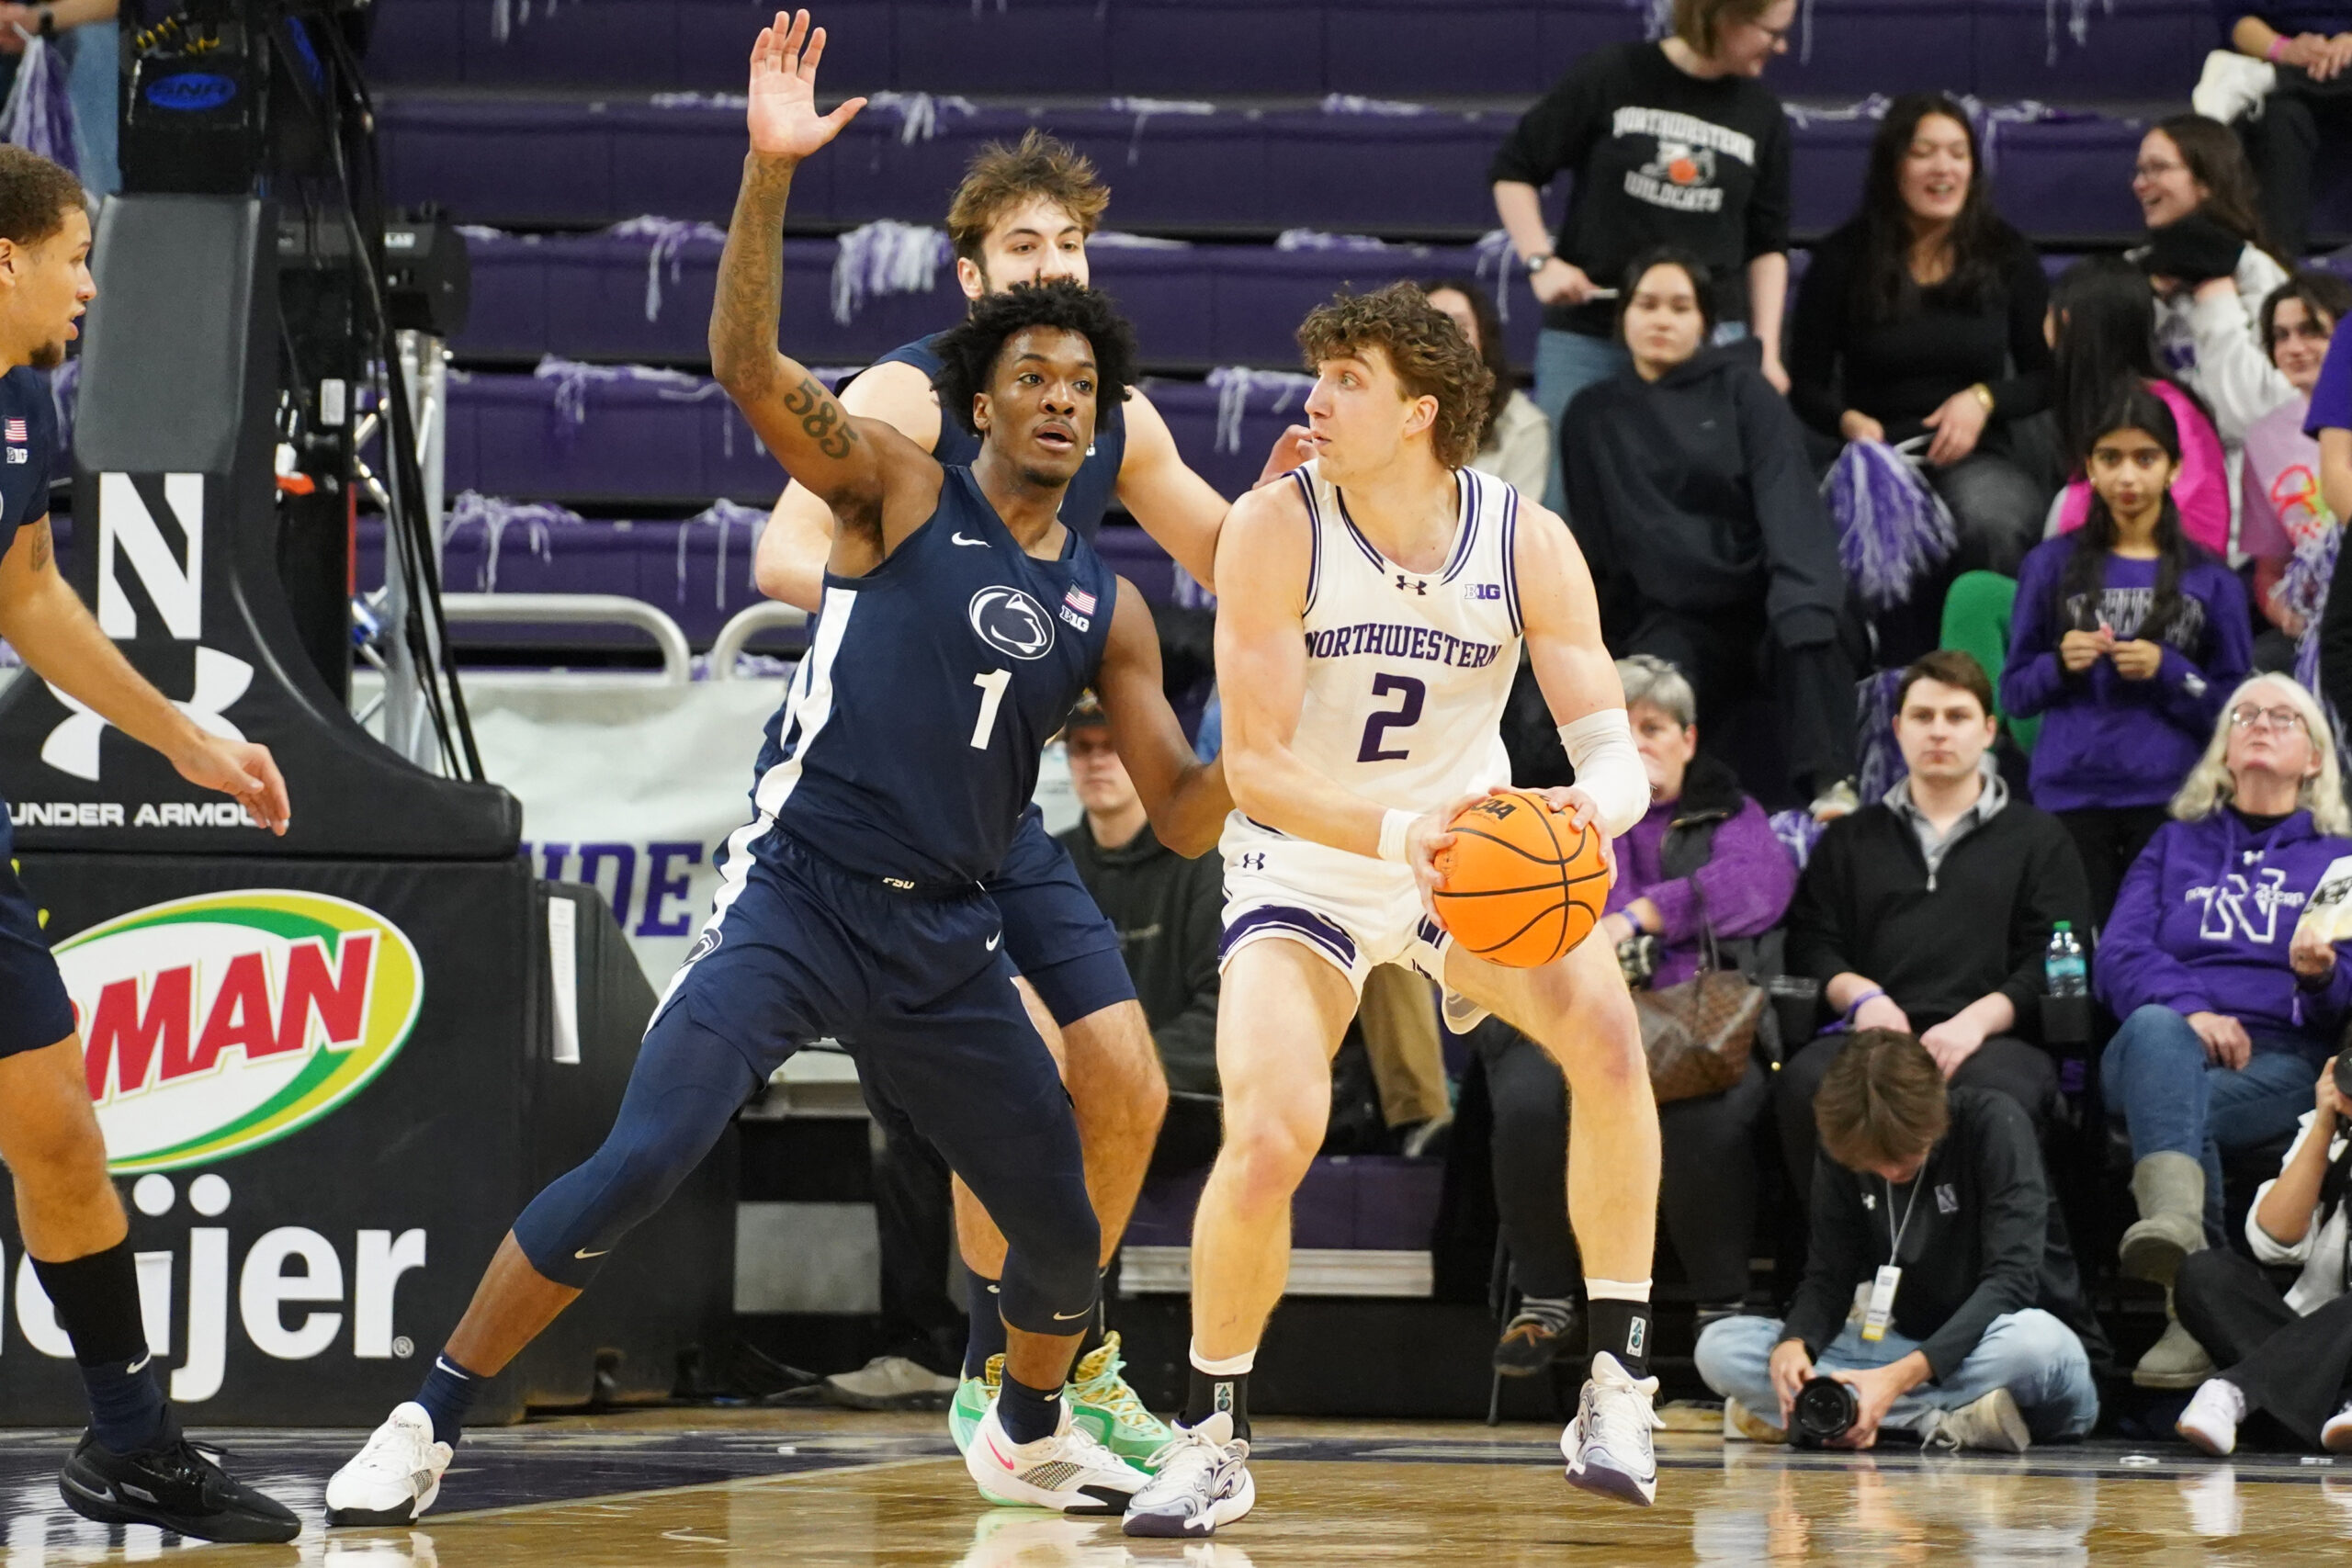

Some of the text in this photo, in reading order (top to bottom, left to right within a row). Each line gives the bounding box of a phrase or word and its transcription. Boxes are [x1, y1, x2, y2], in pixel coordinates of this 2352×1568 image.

[784, 378, 859, 459] 585
[97, 472, 203, 639] N
[1304, 622, 1503, 669] NORTHWESTERN
[969, 668, 1012, 750] 1
[1356, 671, 1427, 763] 2
[6, 802, 290, 827] UNDER ARMOU
[71, 935, 375, 1103] MAN
